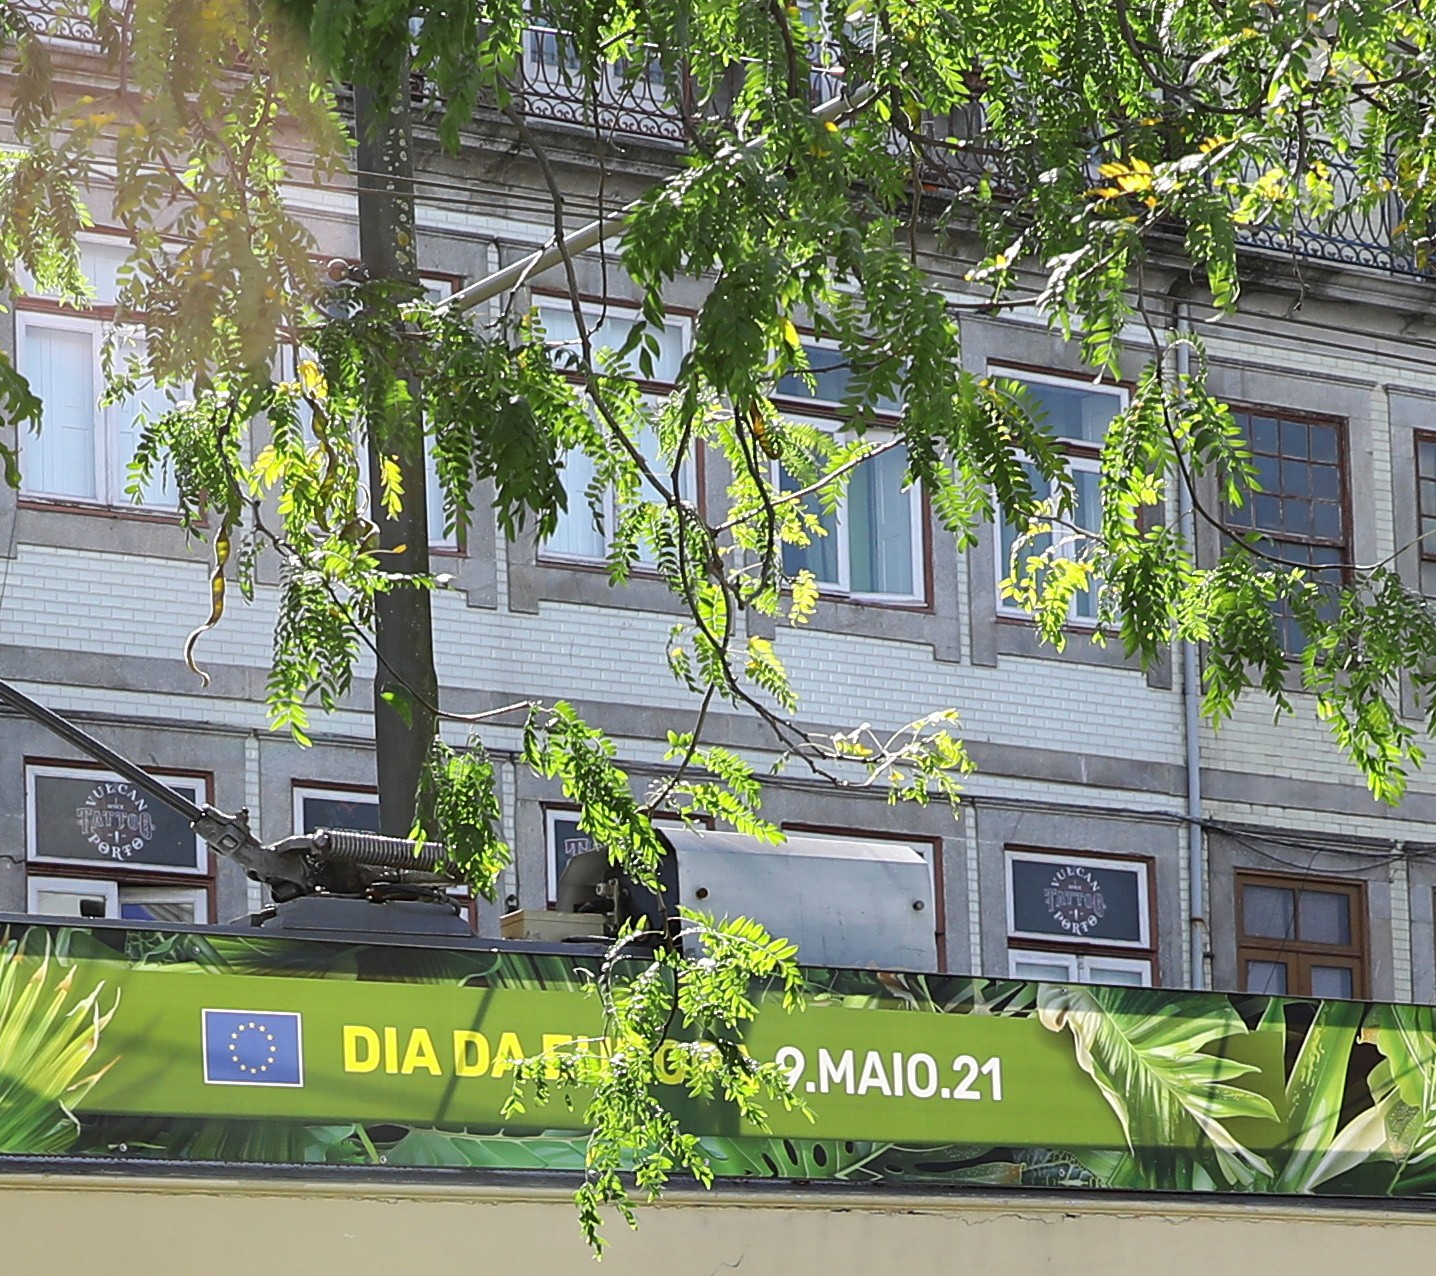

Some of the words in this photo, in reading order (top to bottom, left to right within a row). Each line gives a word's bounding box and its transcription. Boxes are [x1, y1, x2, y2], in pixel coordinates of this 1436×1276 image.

[85, 783, 148, 811] VULCAN
[87, 831, 144, 860] PORTO
[1050, 866, 1100, 892] VULCAN
[1053, 911, 1098, 935] PORTO
[342, 1025, 443, 1076] DIA
[452, 1030, 530, 1079] DA
[774, 1045, 1004, 1102] 9.MAIO.21
